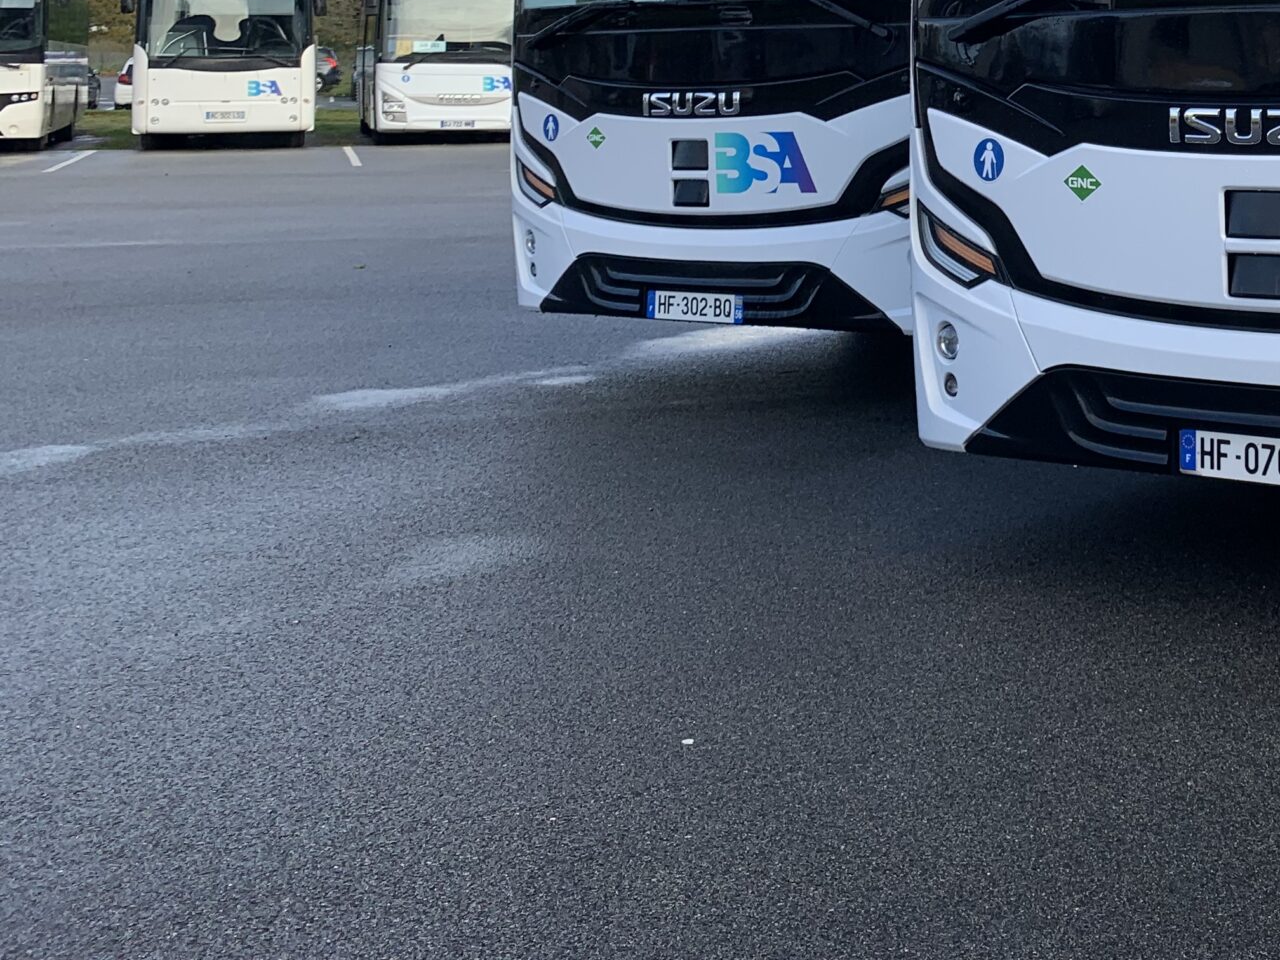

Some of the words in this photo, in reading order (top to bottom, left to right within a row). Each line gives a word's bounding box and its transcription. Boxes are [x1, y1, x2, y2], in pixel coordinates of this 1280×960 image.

[247, 80, 282, 96] BSA
[642, 92, 740, 117] ISUZU
[714, 131, 818, 194] BSA
[1068, 176, 1097, 190] GNC
[1185, 453, 1192, 463] F
